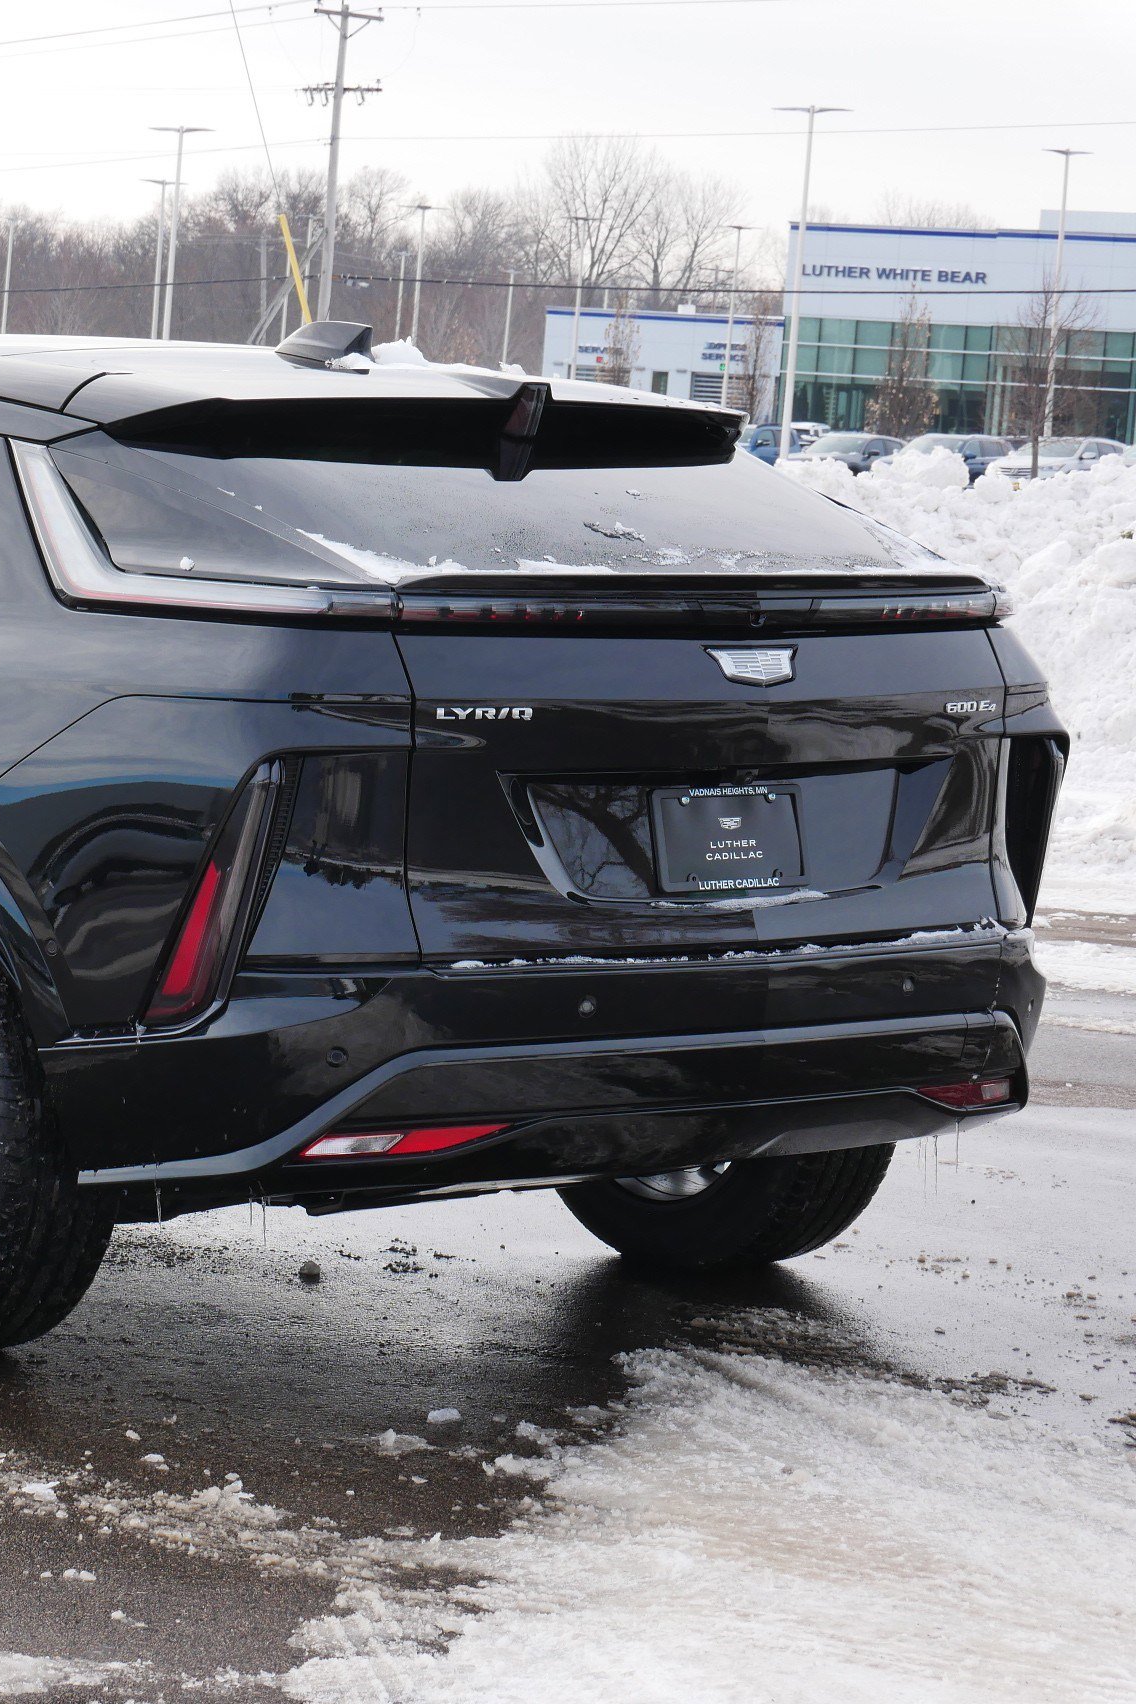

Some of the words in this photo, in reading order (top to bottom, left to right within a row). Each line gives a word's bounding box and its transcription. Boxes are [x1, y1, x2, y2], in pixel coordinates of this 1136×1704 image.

[801, 264, 871, 279] LUTHER
[876, 267, 932, 282] WHITE
[937, 270, 987, 284] BEAR
[945, 701, 978, 713] 600
[689, 788, 721, 796] VADNAIS
[722, 787, 755, 795] HEIGHTS,
[756, 786, 768, 794] MN
[710, 839, 757, 849] LUTHER
[705, 851, 764, 861] CADILLAC
[698, 879, 735, 890] LUTHER
[735, 877, 780, 889] CADILLAC
